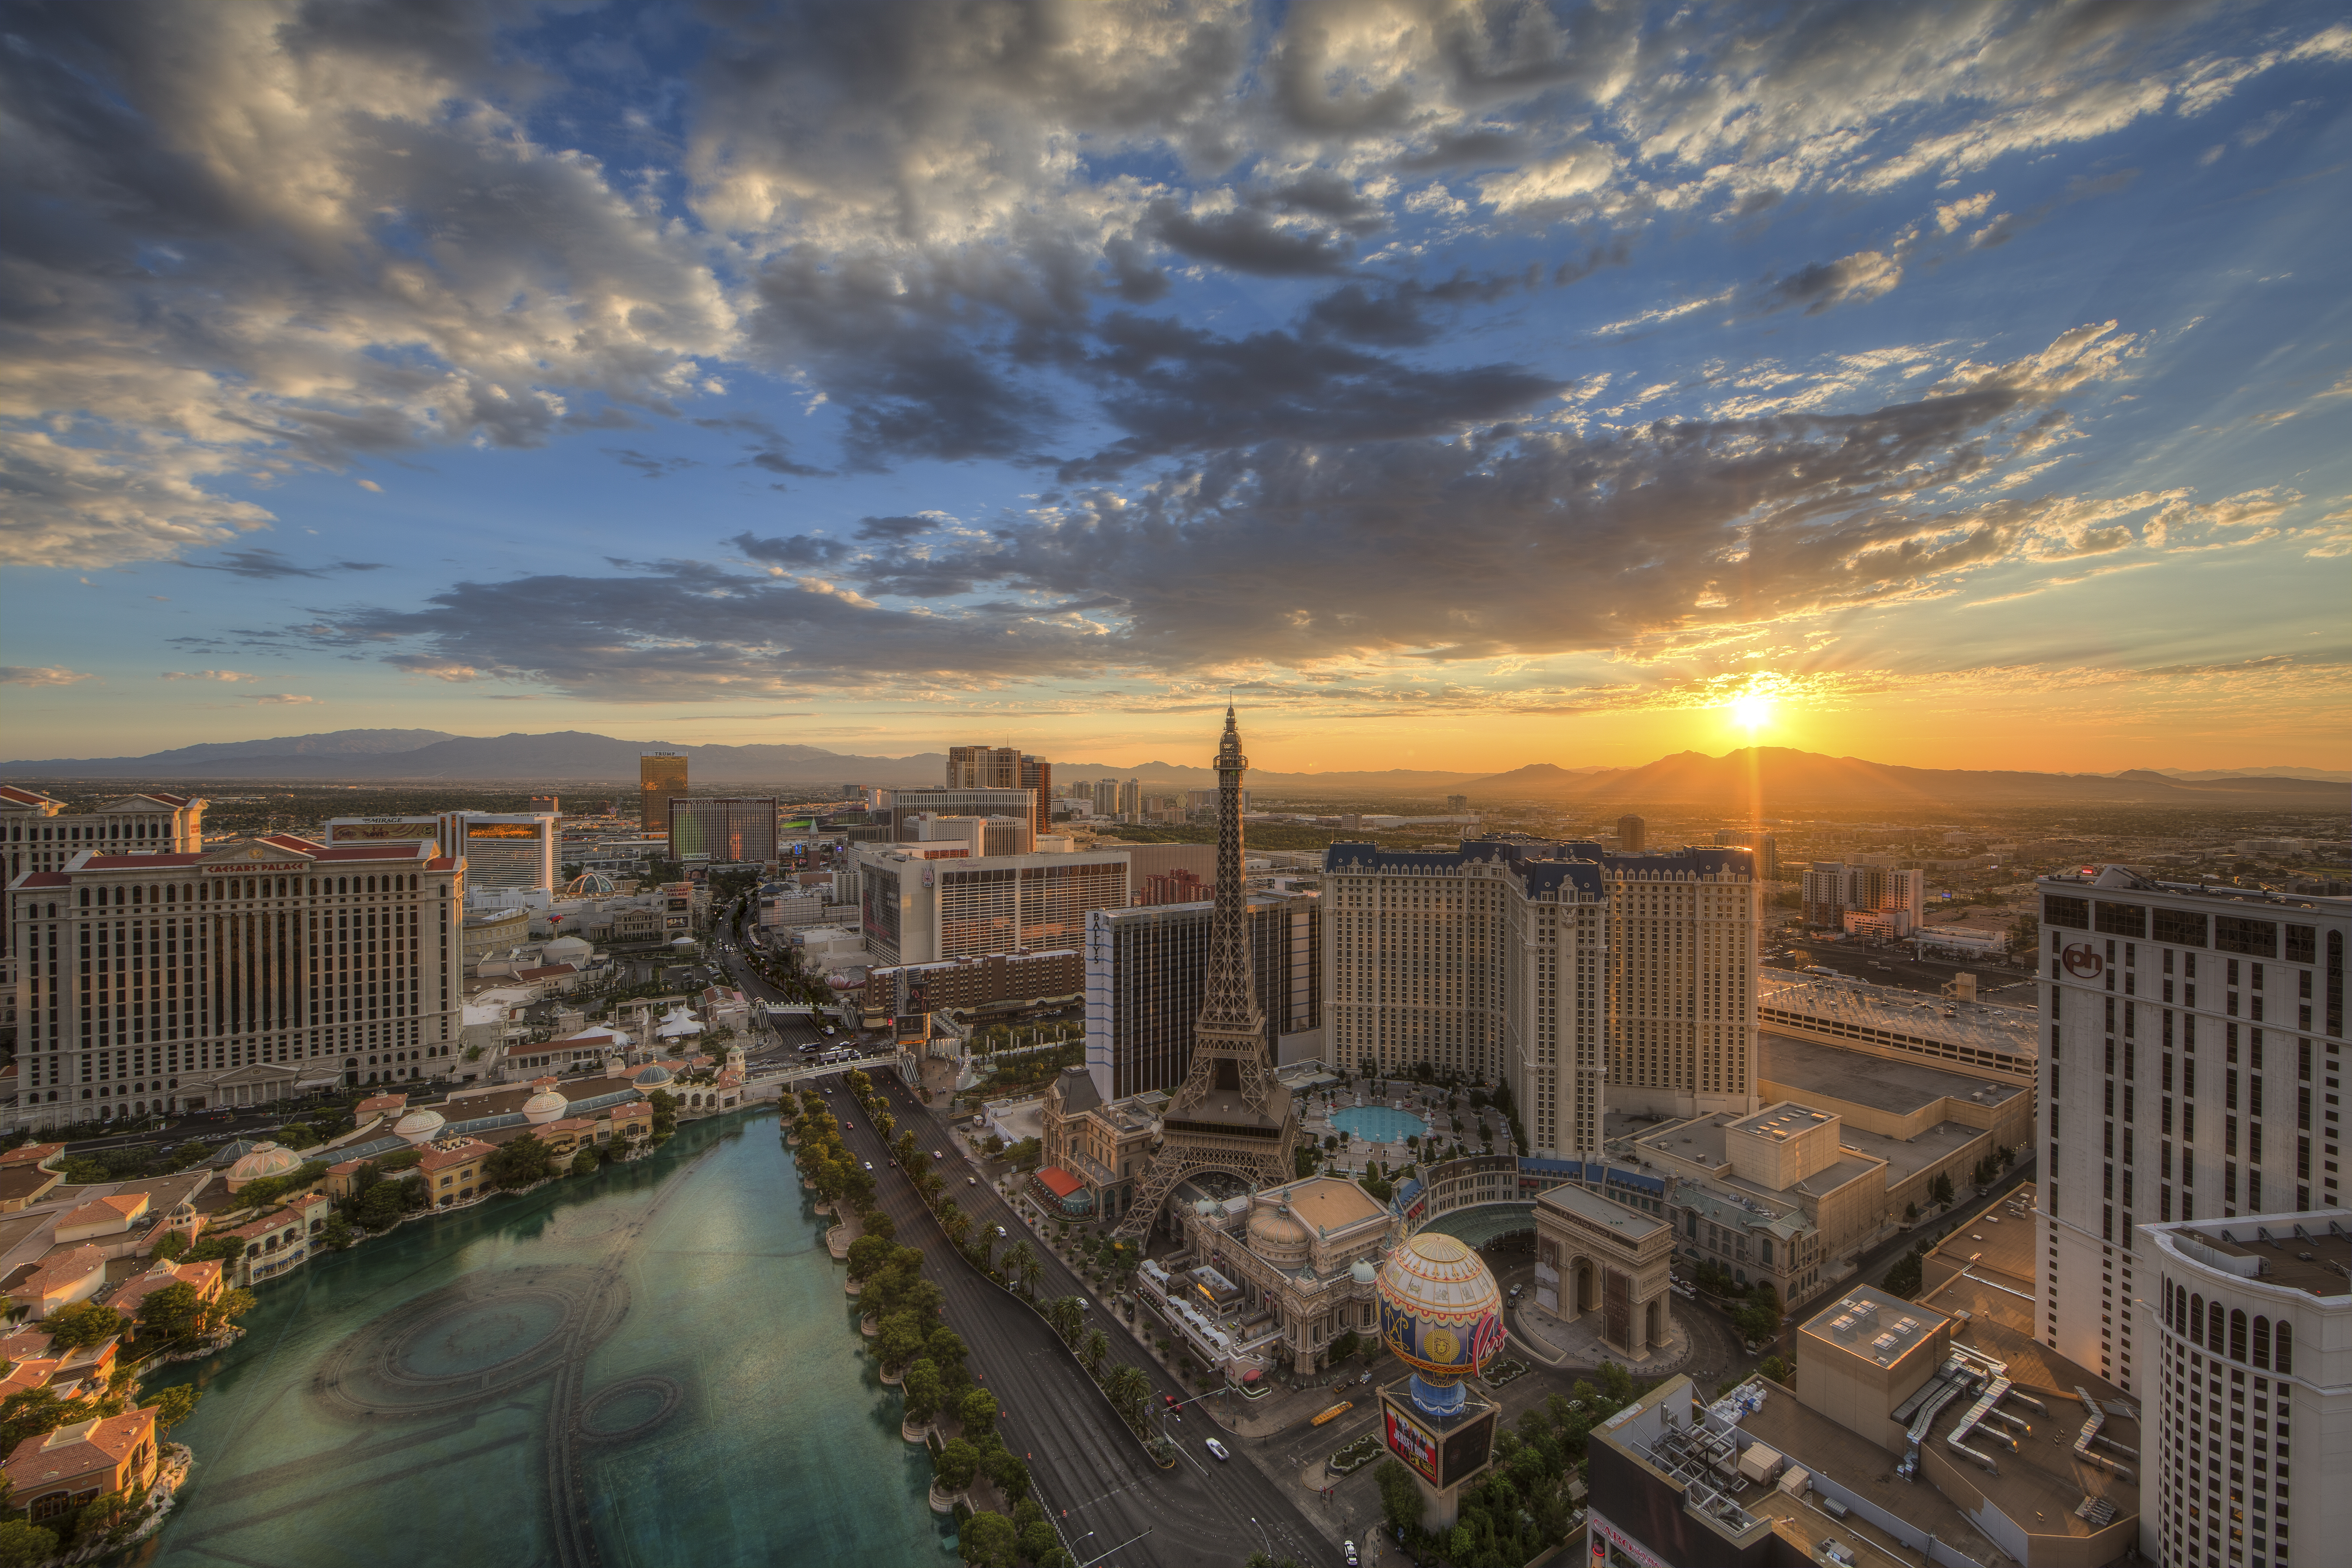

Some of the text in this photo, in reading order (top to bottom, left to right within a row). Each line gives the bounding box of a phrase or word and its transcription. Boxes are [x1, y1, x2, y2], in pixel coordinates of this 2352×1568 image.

[207, 862, 303, 873] CAESARS PALACE
[1569, 1214, 1579, 1225] Fury
[1581, 1219, 1590, 1228] For
[1591, 1224, 1608, 1236] Flavor
[1606, 1297, 1628, 1311] GORDON
[1606, 1302, 1628, 1316] RAMSAY
[1472, 1312, 1508, 1378] Paris
[1394, 1428, 1429, 1462] JERSEY BOYS
[1593, 1518, 1633, 1552] CABO
